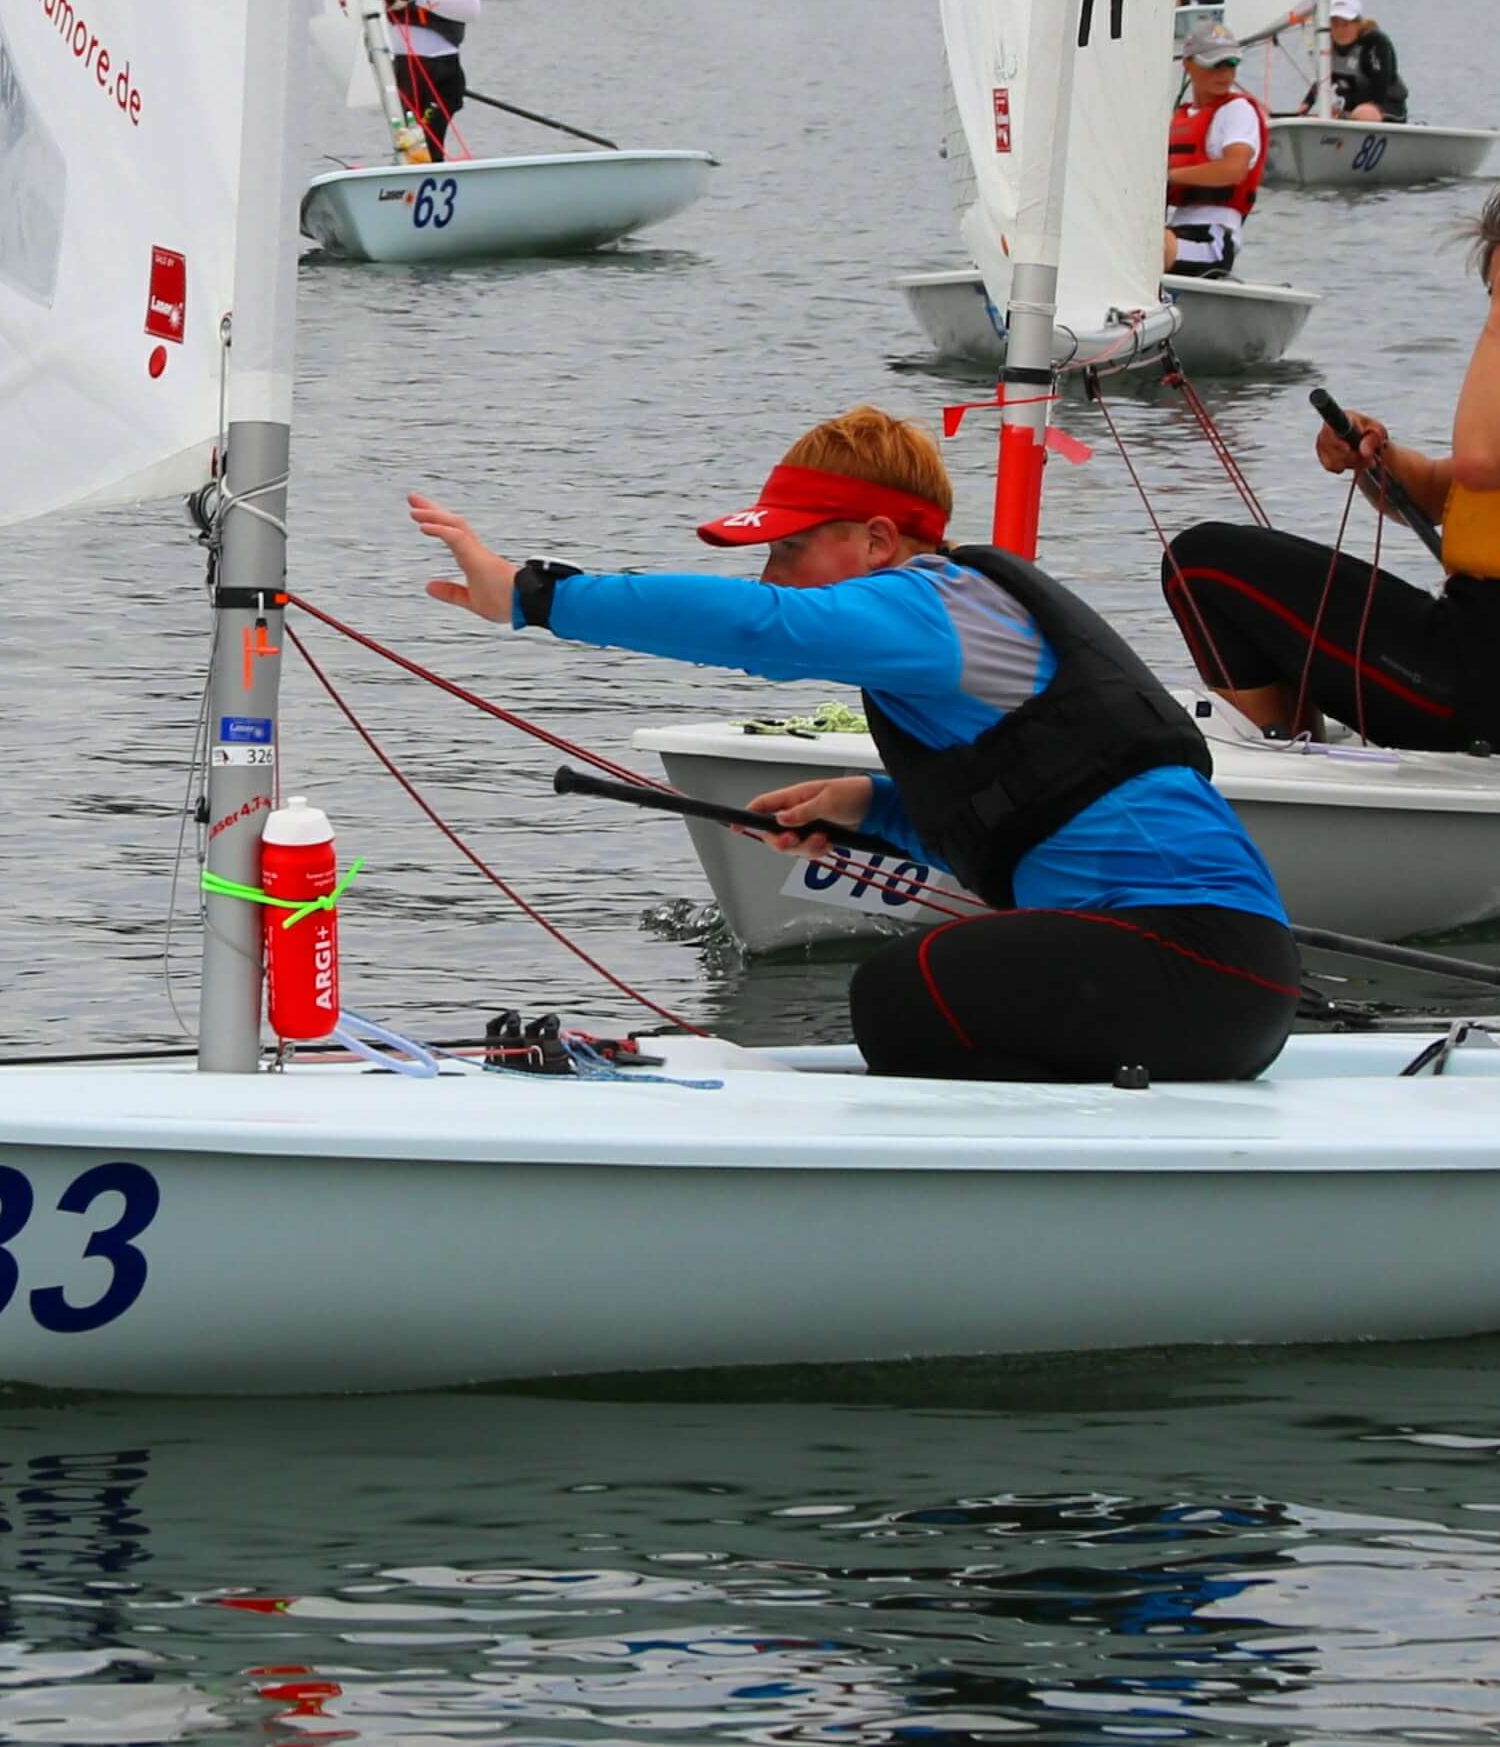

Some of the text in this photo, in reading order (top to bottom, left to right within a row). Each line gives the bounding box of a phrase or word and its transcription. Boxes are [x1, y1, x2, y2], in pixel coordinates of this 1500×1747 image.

[1351, 134, 1388, 172] 80
[413, 177, 458, 229] 63
[314, 925, 332, 1011] ARGI+
